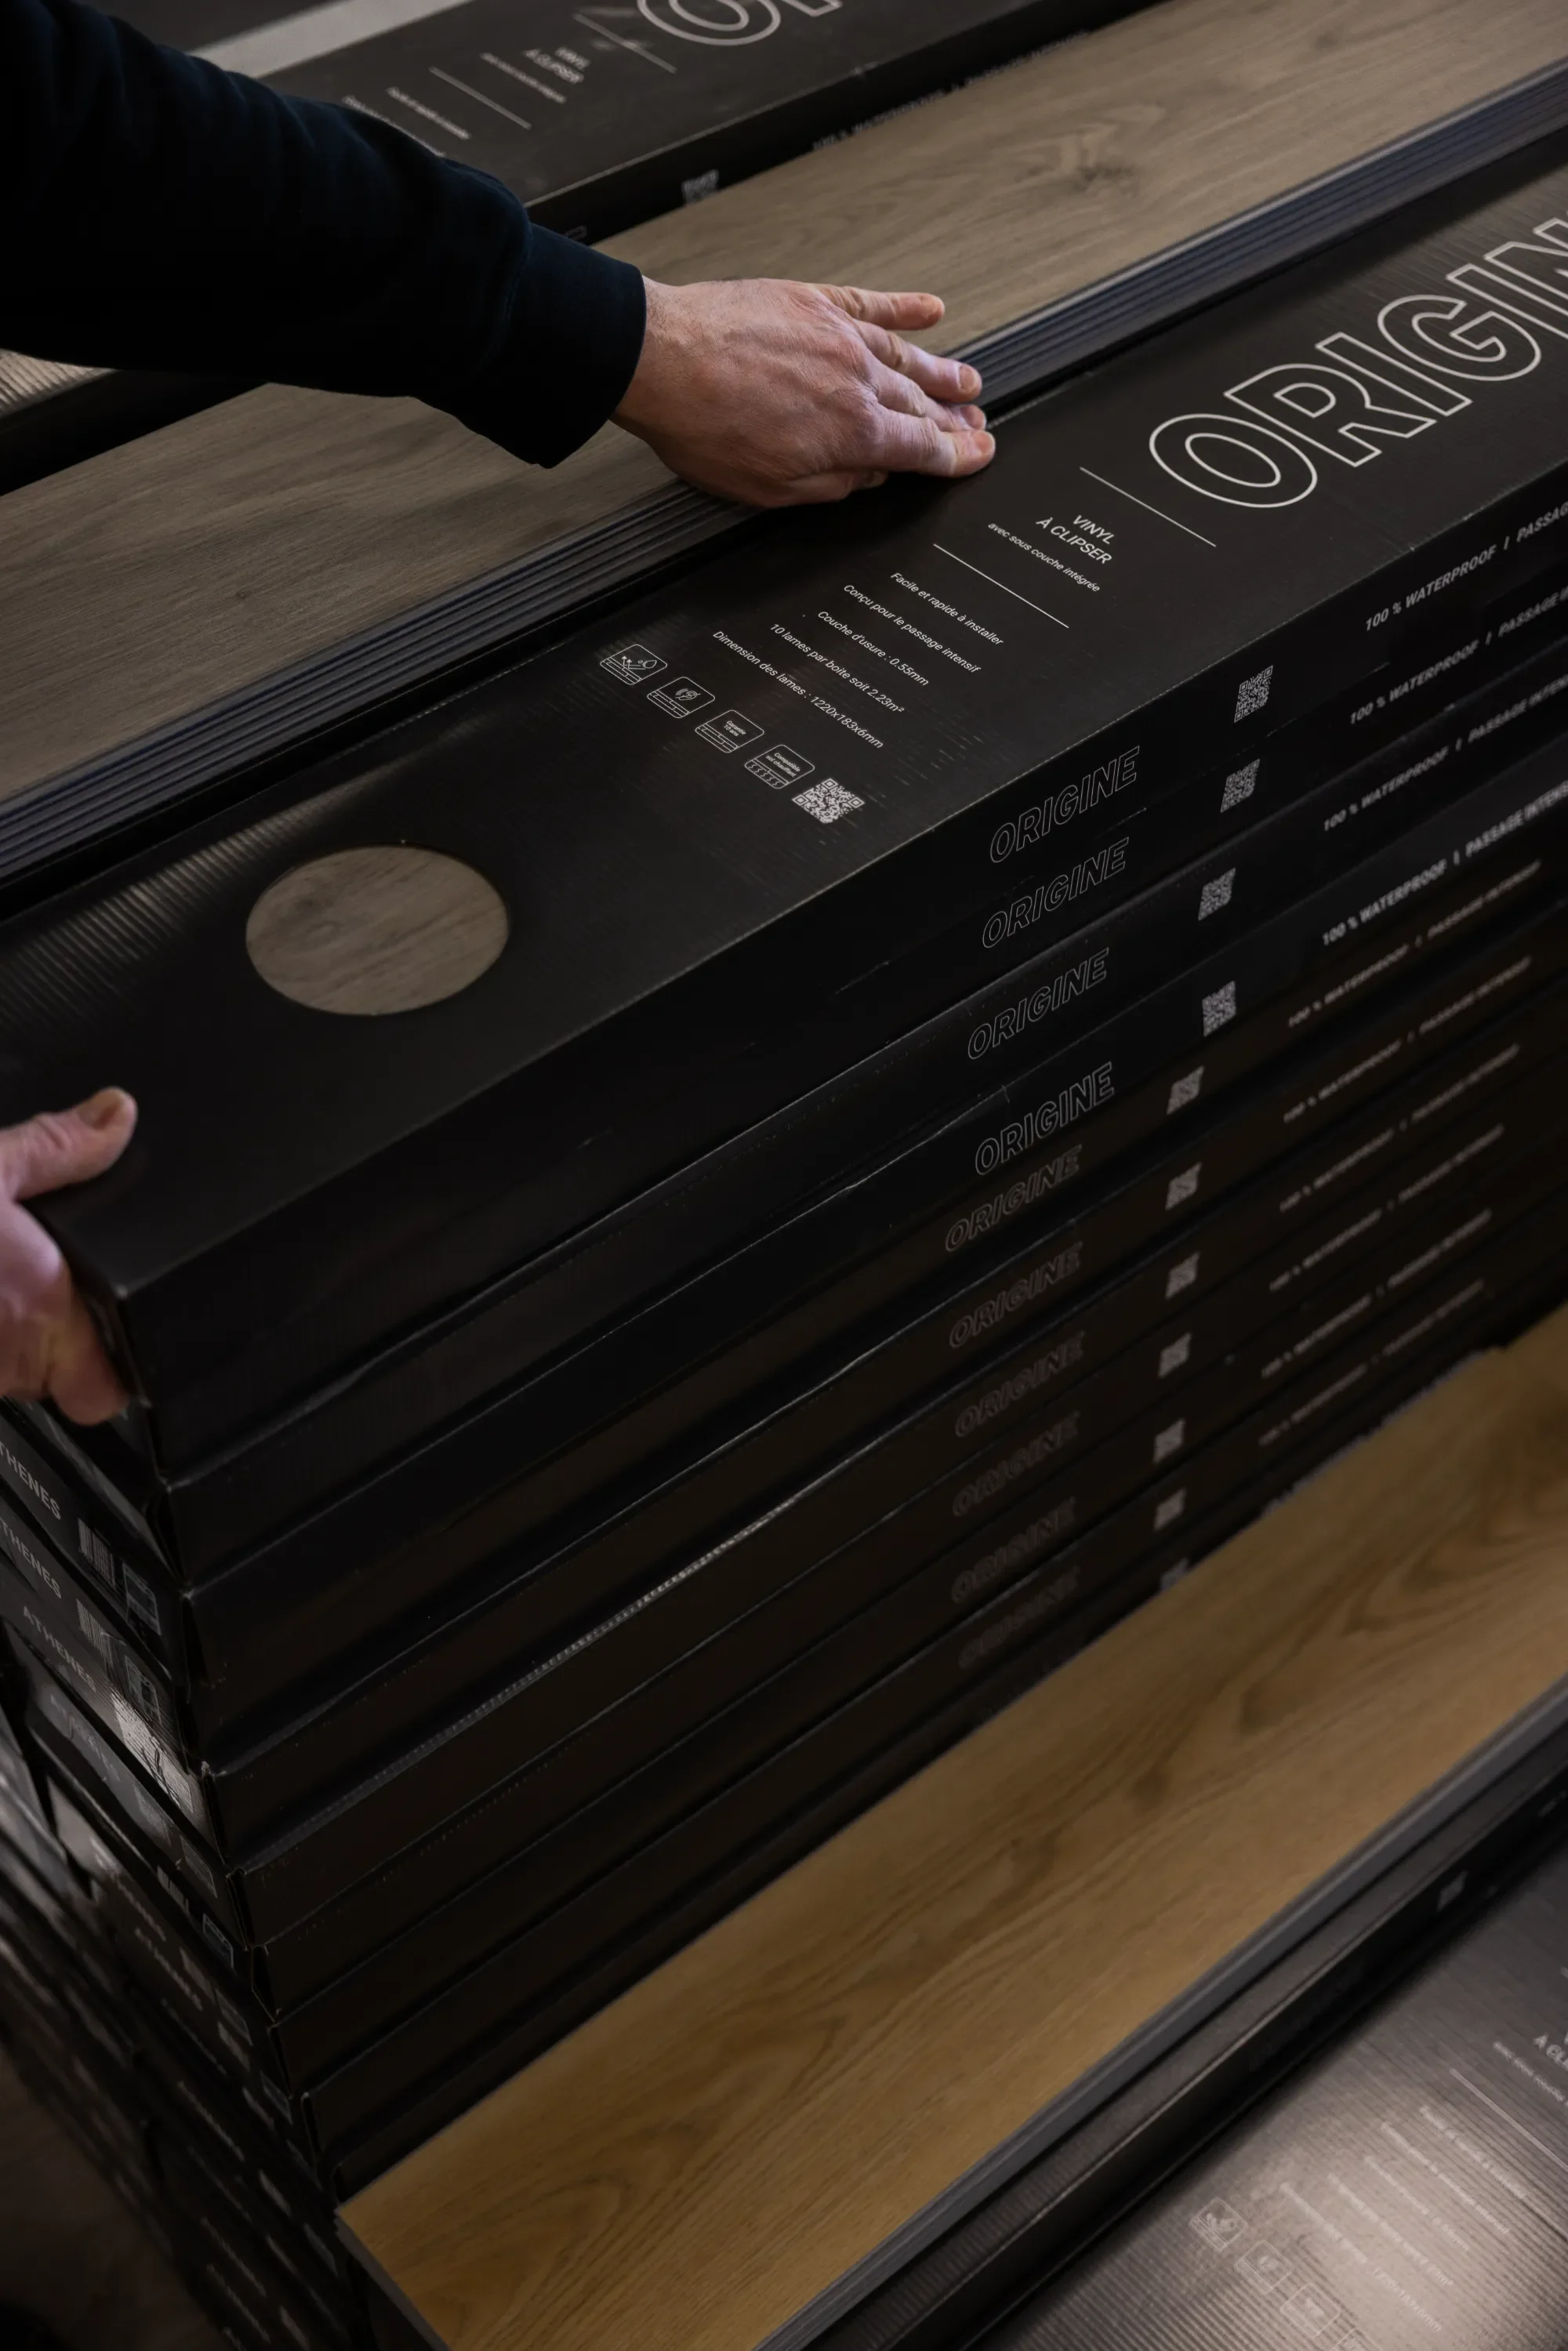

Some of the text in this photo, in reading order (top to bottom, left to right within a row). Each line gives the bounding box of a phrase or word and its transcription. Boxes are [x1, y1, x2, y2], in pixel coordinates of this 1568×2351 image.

[988, 523, 1101, 592] avec sous couche intégrée
[1035, 517, 1112, 564] À CLIPSER
[1073, 514, 1115, 545] VINYL
[844, 585, 982, 673] Conçu pour le passage intensif
[891, 572, 920, 593] Facile
[918, 590, 931, 600] et
[928, 597, 958, 617] rapide
[964, 619, 1004, 645] installer
[1365, 608, 1389, 631] 100
[1405, 544, 1497, 609] WATERPROOF
[713, 630, 760, 665] Dimension
[759, 661, 779, 677] des
[776, 673, 807, 695] lames
[810, 696, 884, 749] 1220x183x6mm
[770, 623, 905, 713] 10 lames par boite soit 2.23m²
[818, 610, 853, 636] Couche
[851, 633, 886, 658] d'usure
[890, 658, 929, 686] 0.55mm
[1350, 702, 1374, 724] 100
[1389, 639, 1479, 702] WATERPROOF
[727, 720, 746, 735] Garantie
[775, 753, 800, 771] Compatible
[989, 746, 1140, 863] ORIGINE
[982, 836, 1130, 949] ORIGINE
[967, 947, 1109, 1059] ORIGINE
[975, 1061, 1116, 1176] ORIGINE
[945, 1144, 1083, 1253] ORIGINE
